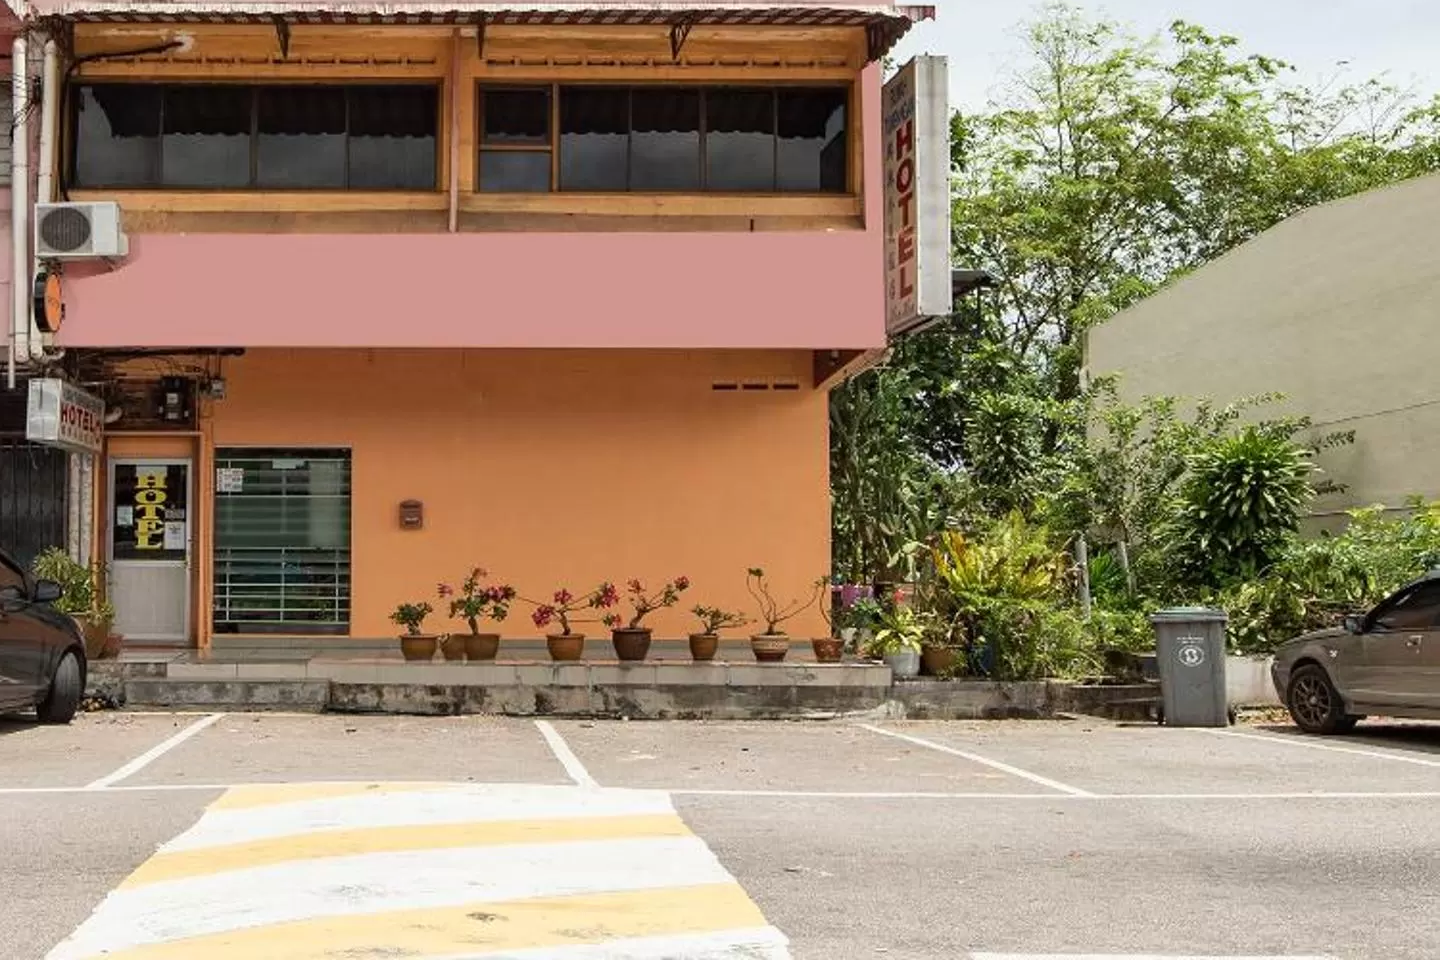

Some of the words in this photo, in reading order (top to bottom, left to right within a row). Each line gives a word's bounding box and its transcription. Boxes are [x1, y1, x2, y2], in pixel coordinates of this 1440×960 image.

[896, 120, 913, 299] HOTEL
[61, 403, 95, 433] HOTEL
[135, 472, 167, 549] HOTEL
